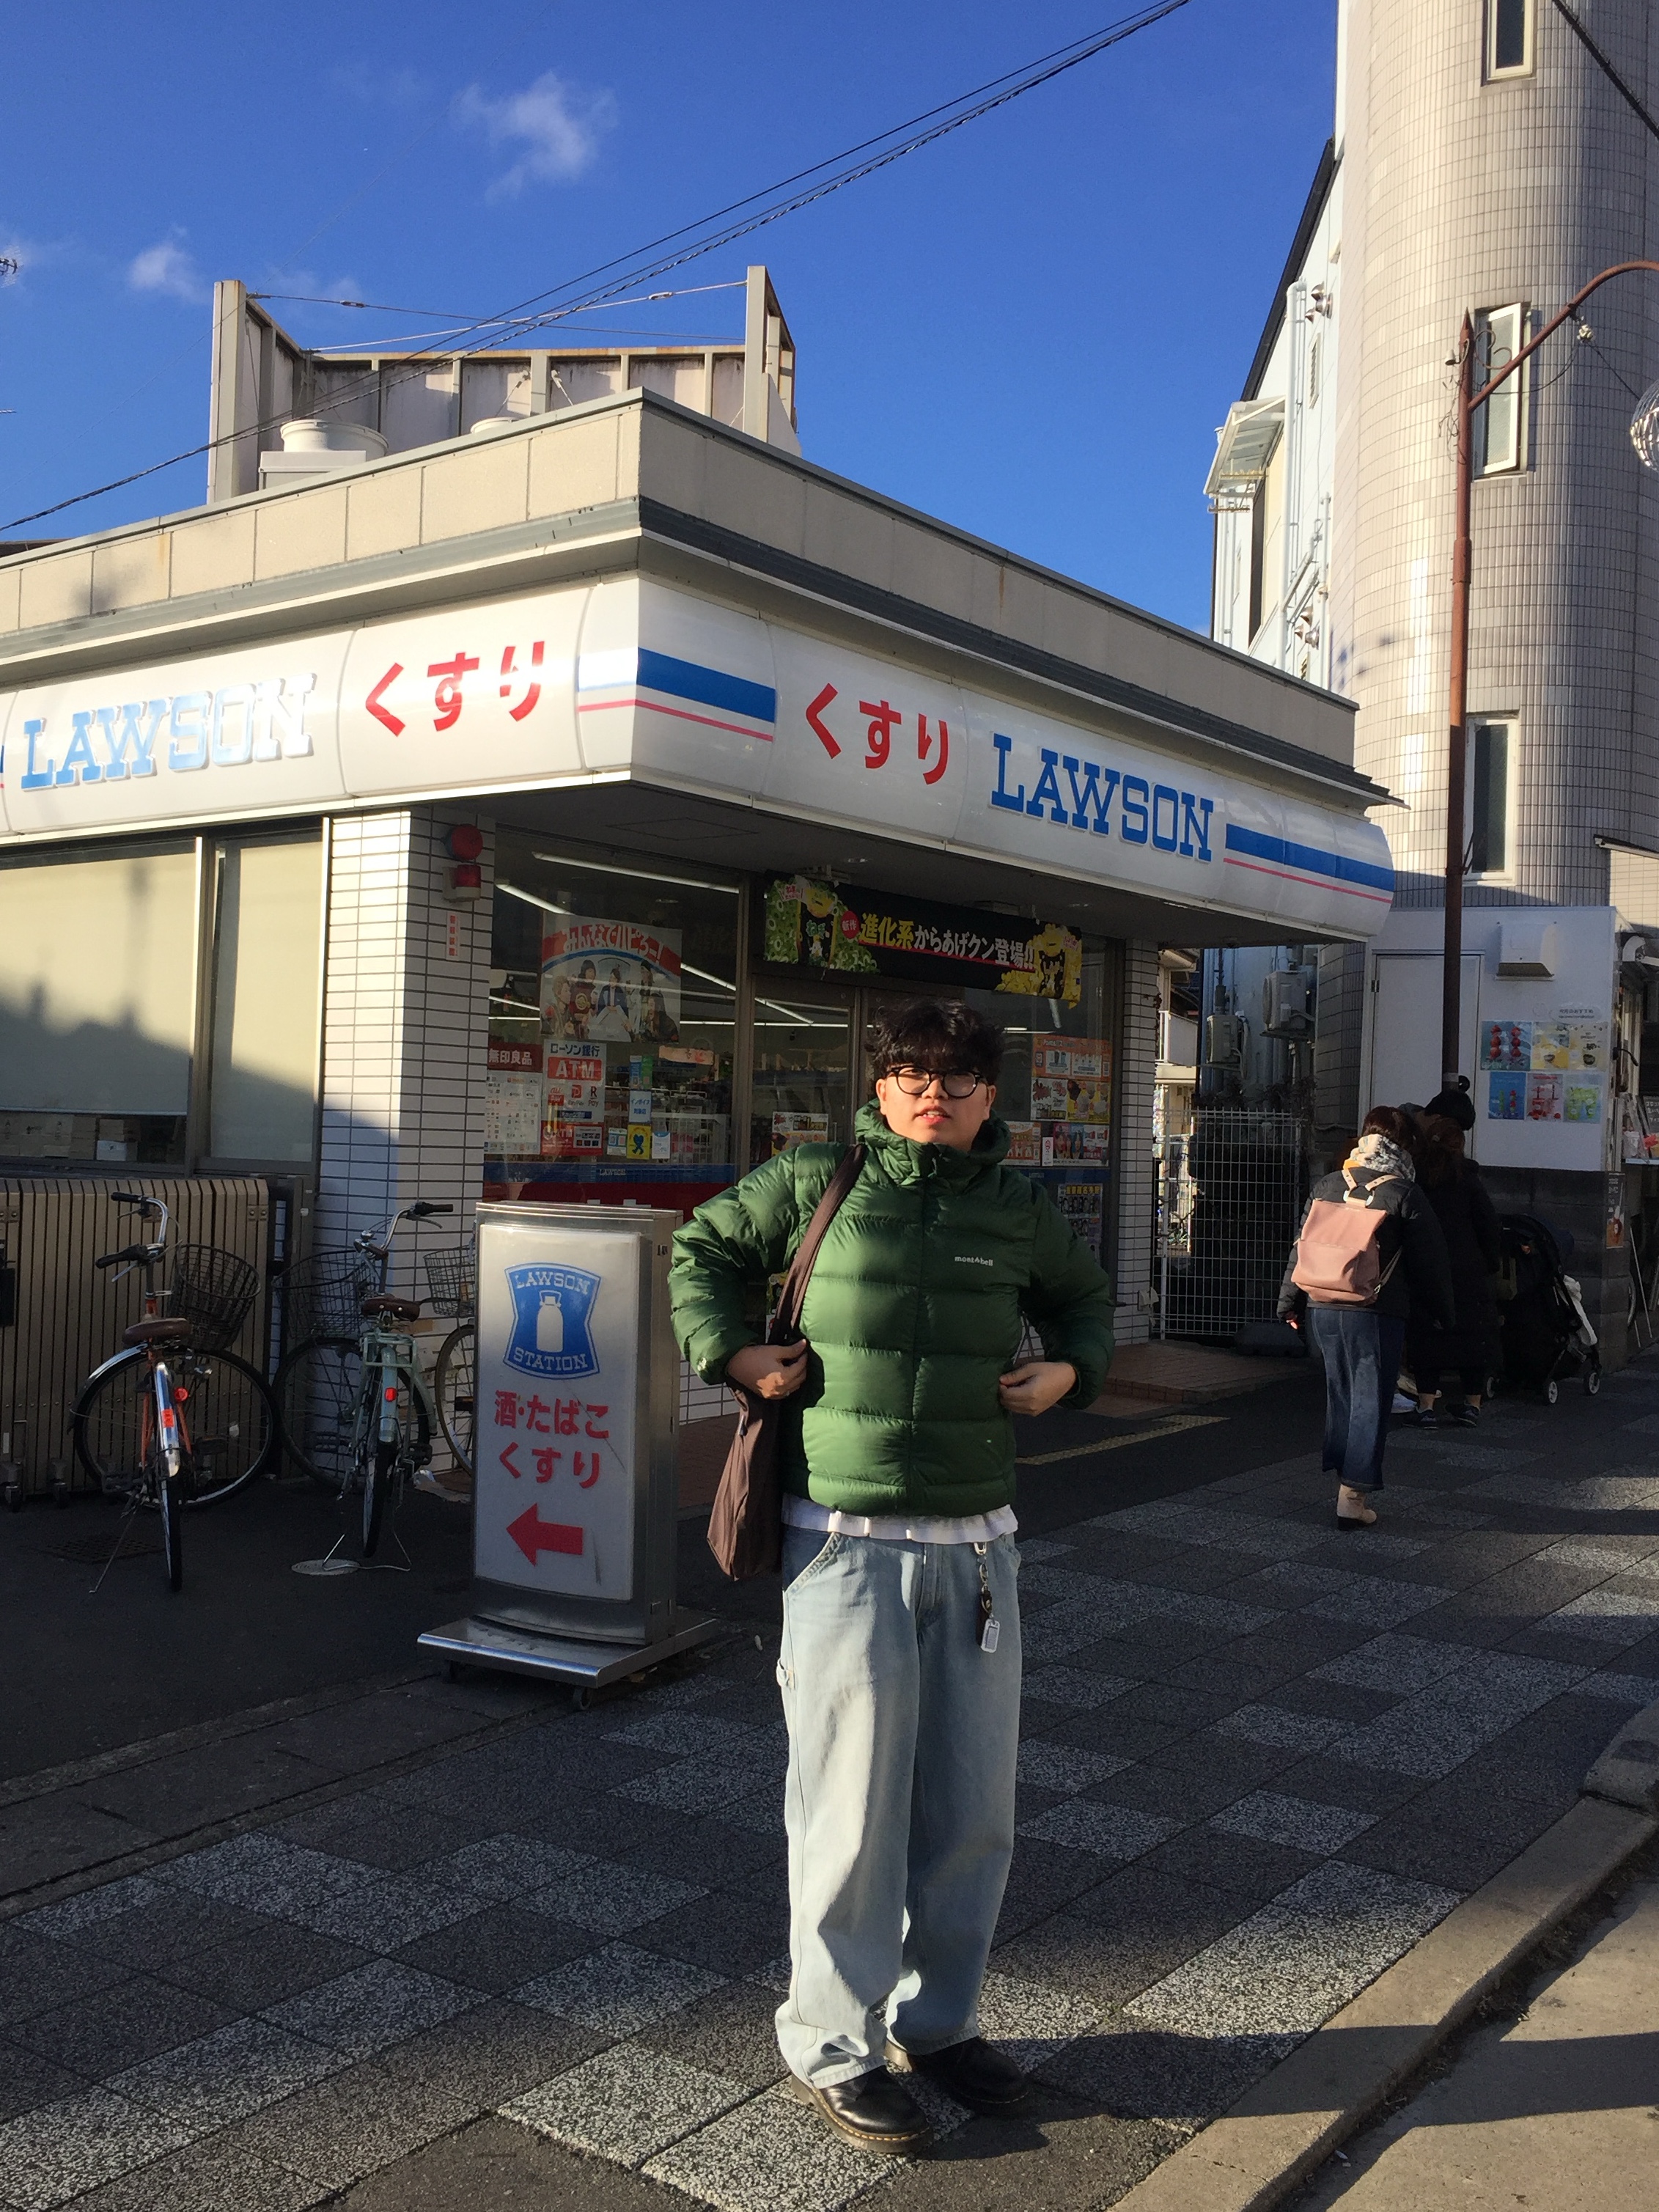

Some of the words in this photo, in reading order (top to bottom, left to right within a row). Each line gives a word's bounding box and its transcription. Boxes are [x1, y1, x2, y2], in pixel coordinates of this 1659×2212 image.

[365, 640, 545, 737] くすり
[21, 672, 316, 791] LAWSON
[805, 683, 949, 785] くすり
[990, 732, 1214, 862] LAWSON
[488, 1048, 532, 1065] 無印良品
[550, 1043, 600, 1057] ローソン銀行
[555, 1059, 595, 1079] ATM
[588, 1100, 599, 1108] Pay
[514, 1270, 592, 1295] LAWSON
[513, 1345, 589, 1371] STATION
[499, 1441, 601, 1490] くすり
